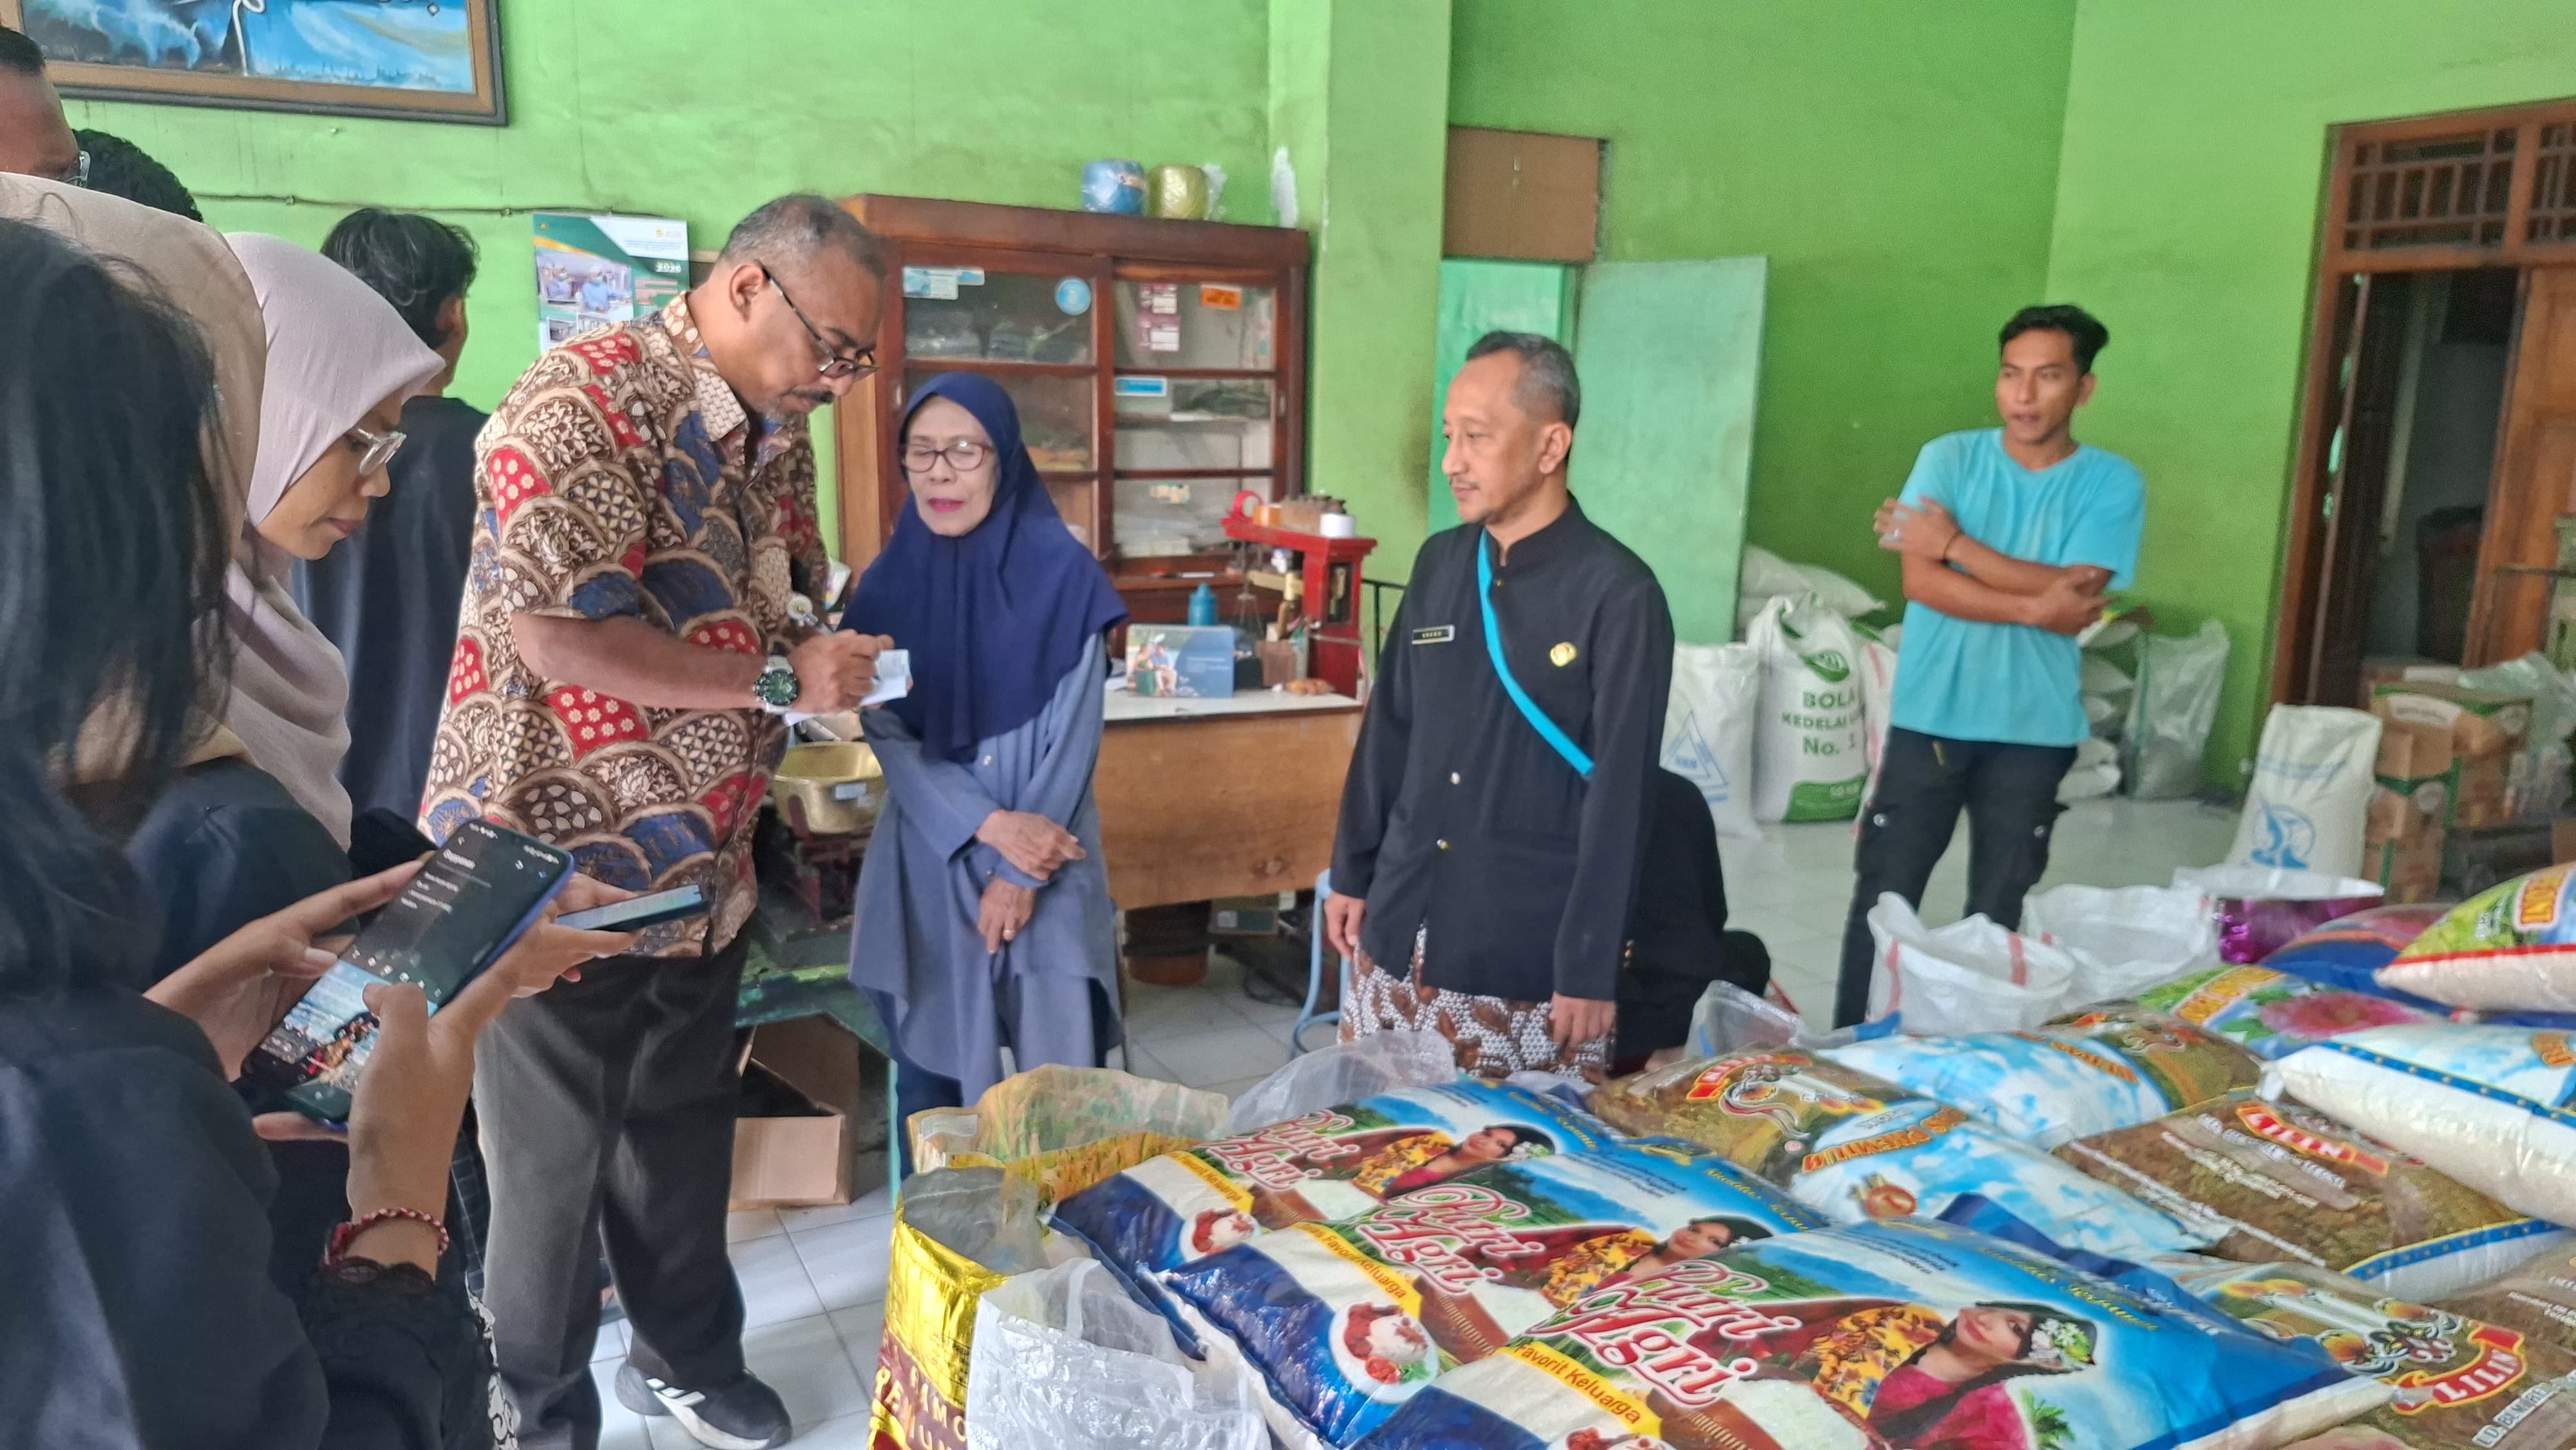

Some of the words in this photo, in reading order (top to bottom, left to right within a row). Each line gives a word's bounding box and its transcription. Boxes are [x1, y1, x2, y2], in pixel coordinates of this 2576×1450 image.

[1782, 711, 1846, 730] KEDELAI
[1804, 737, 1840, 755] No.
[1513, 1343, 1569, 1375] Favorit
[1564, 1368, 1641, 1424] Keluarga
[2434, 1348, 2519, 1402] LILIN
